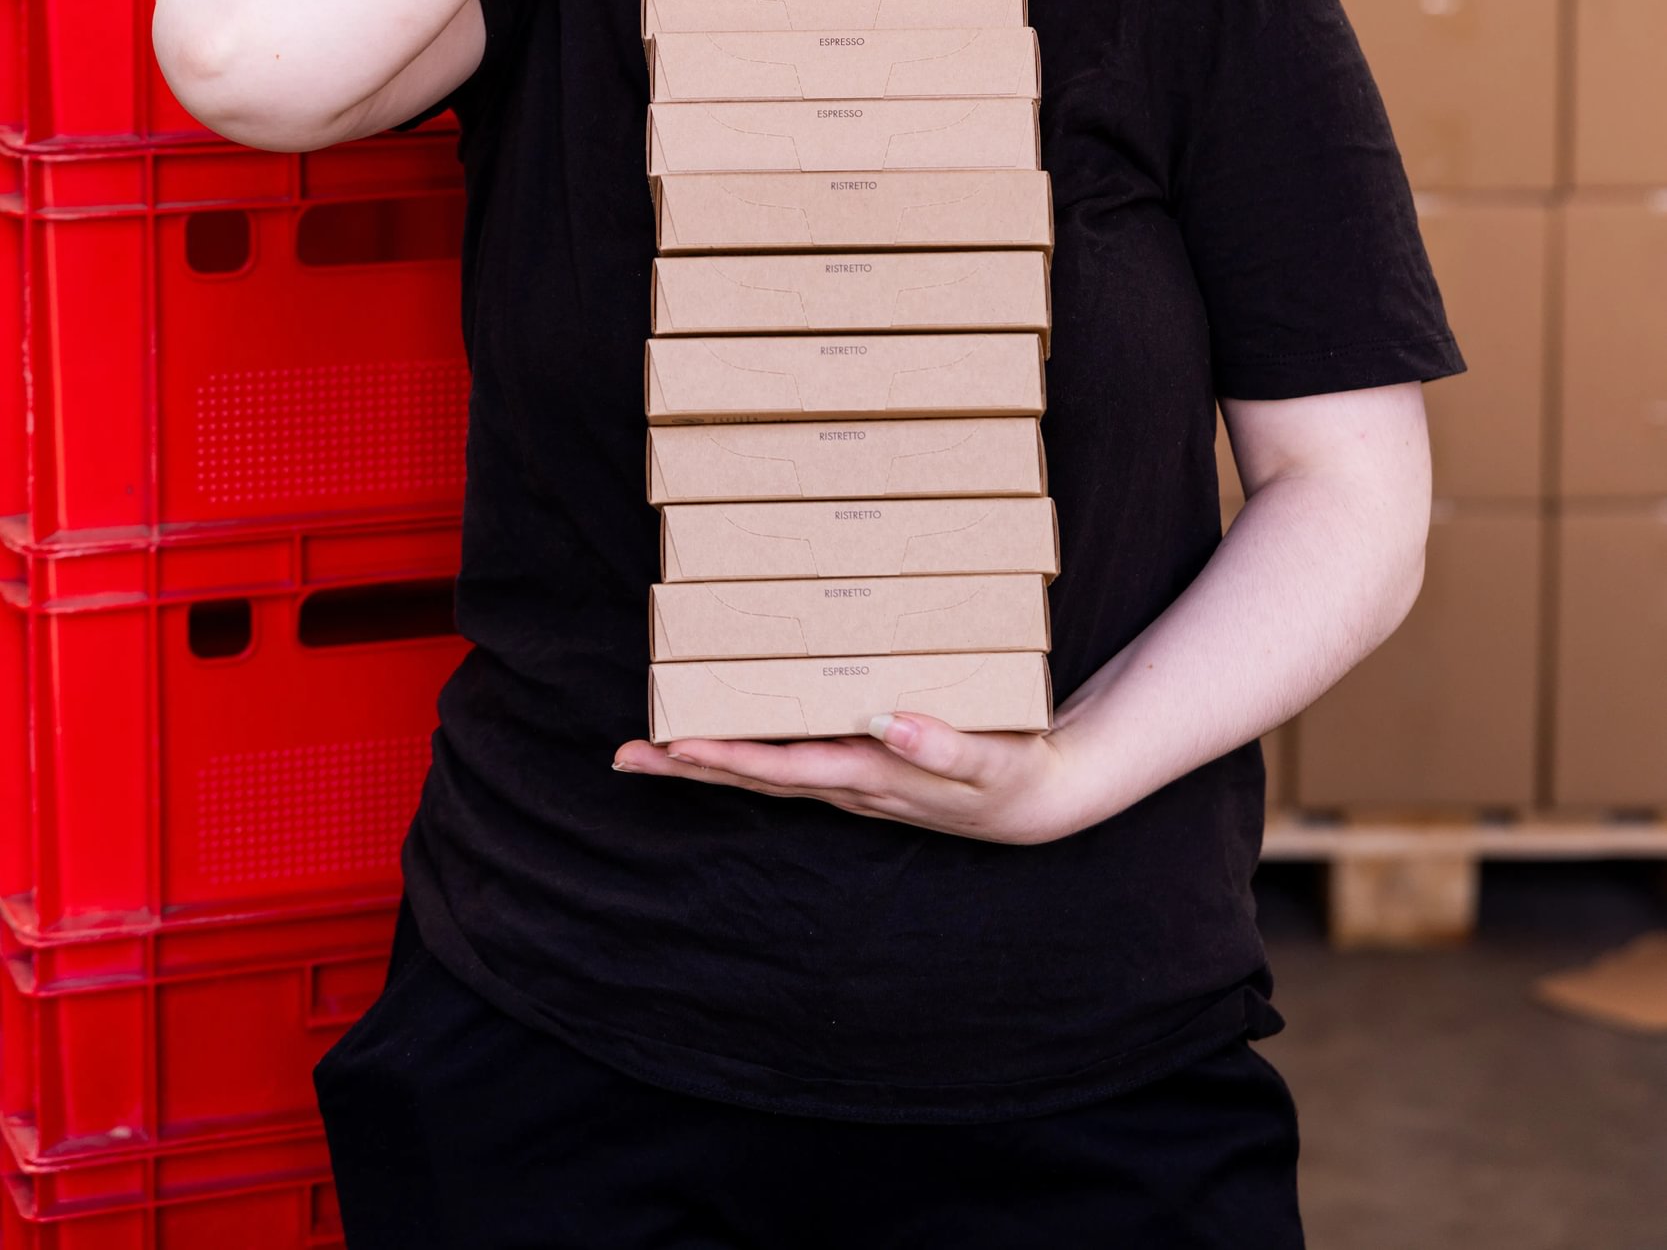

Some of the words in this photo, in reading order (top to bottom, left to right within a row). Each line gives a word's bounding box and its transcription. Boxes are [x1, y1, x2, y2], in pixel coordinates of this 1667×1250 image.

[819, 37, 865, 46] ESPRESSO
[817, 109, 863, 118] ESPRESSO
[830, 181, 878, 190] RISTRETTO
[825, 263, 872, 273] RISTRETTO
[820, 345, 868, 355] RISTRETTO
[819, 431, 866, 441] RISTRETTO
[835, 510, 882, 520] RISTRETTO
[824, 588, 872, 598] RISTRETTO
[822, 666, 870, 676] ESPRESSO
